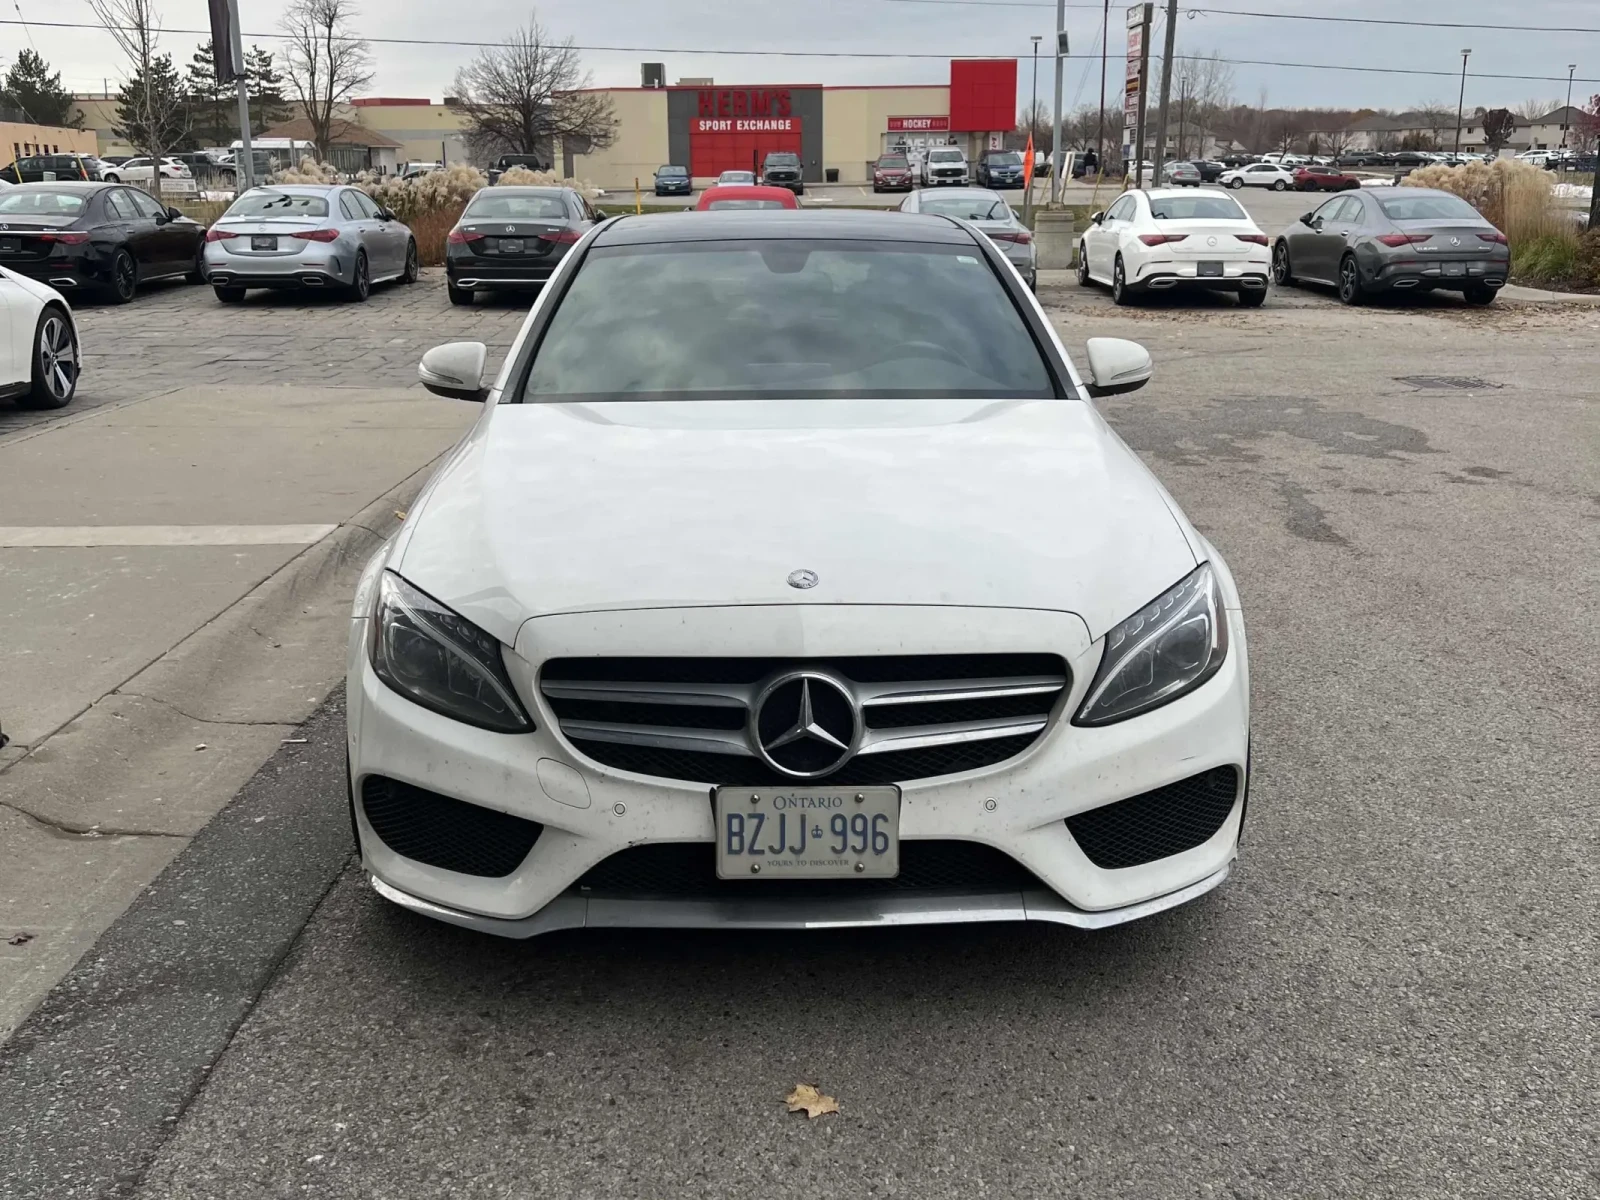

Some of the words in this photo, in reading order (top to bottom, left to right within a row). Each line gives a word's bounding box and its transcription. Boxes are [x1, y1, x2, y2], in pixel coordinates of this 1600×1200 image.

[699, 91, 791, 116] HERM'S
[699, 120, 731, 130] SPORT
[737, 120, 791, 130] EXCHANGE
[903, 120, 931, 128] HOCKEY
[727, 814, 807, 855] BZJJ
[830, 814, 889, 855] 996
